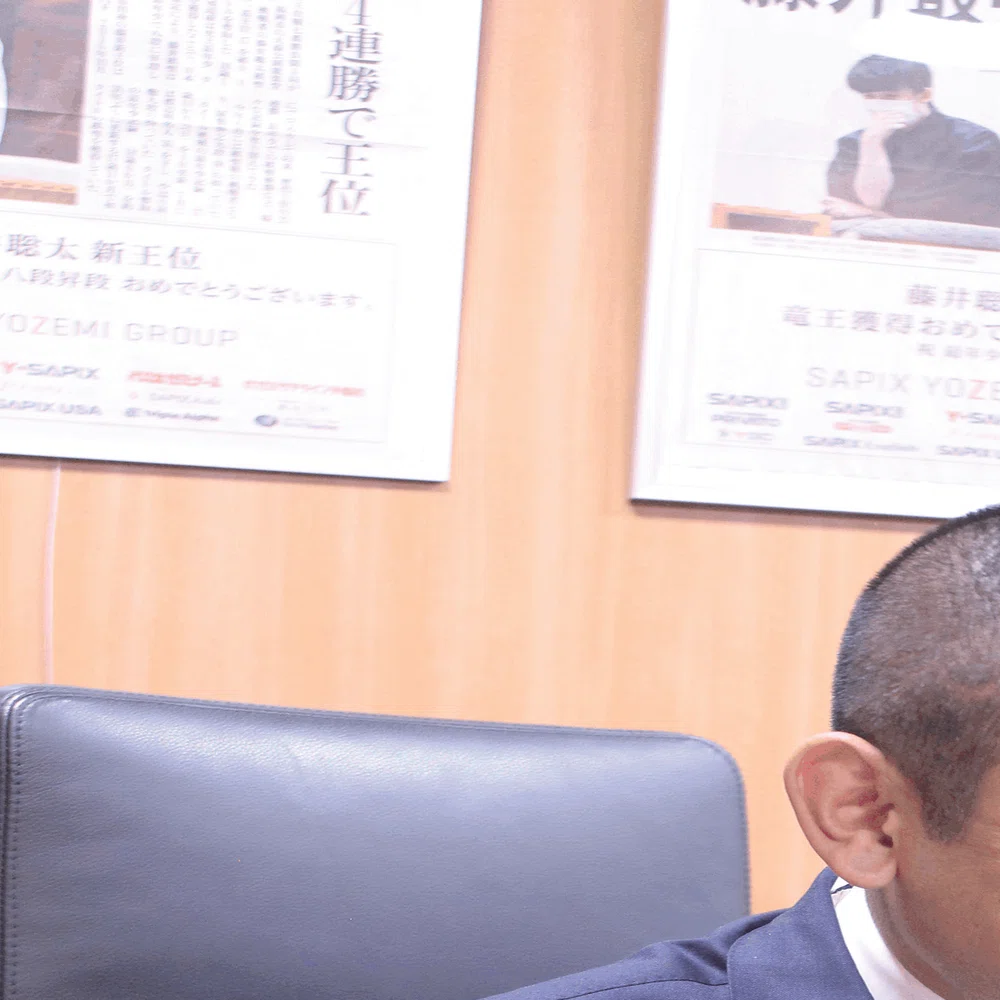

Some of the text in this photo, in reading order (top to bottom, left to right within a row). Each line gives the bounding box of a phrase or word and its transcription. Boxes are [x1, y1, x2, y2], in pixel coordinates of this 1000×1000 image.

[0, 313, 239, 347] OZEMI GROUP
[805, 365, 912, 394] SAPIX
